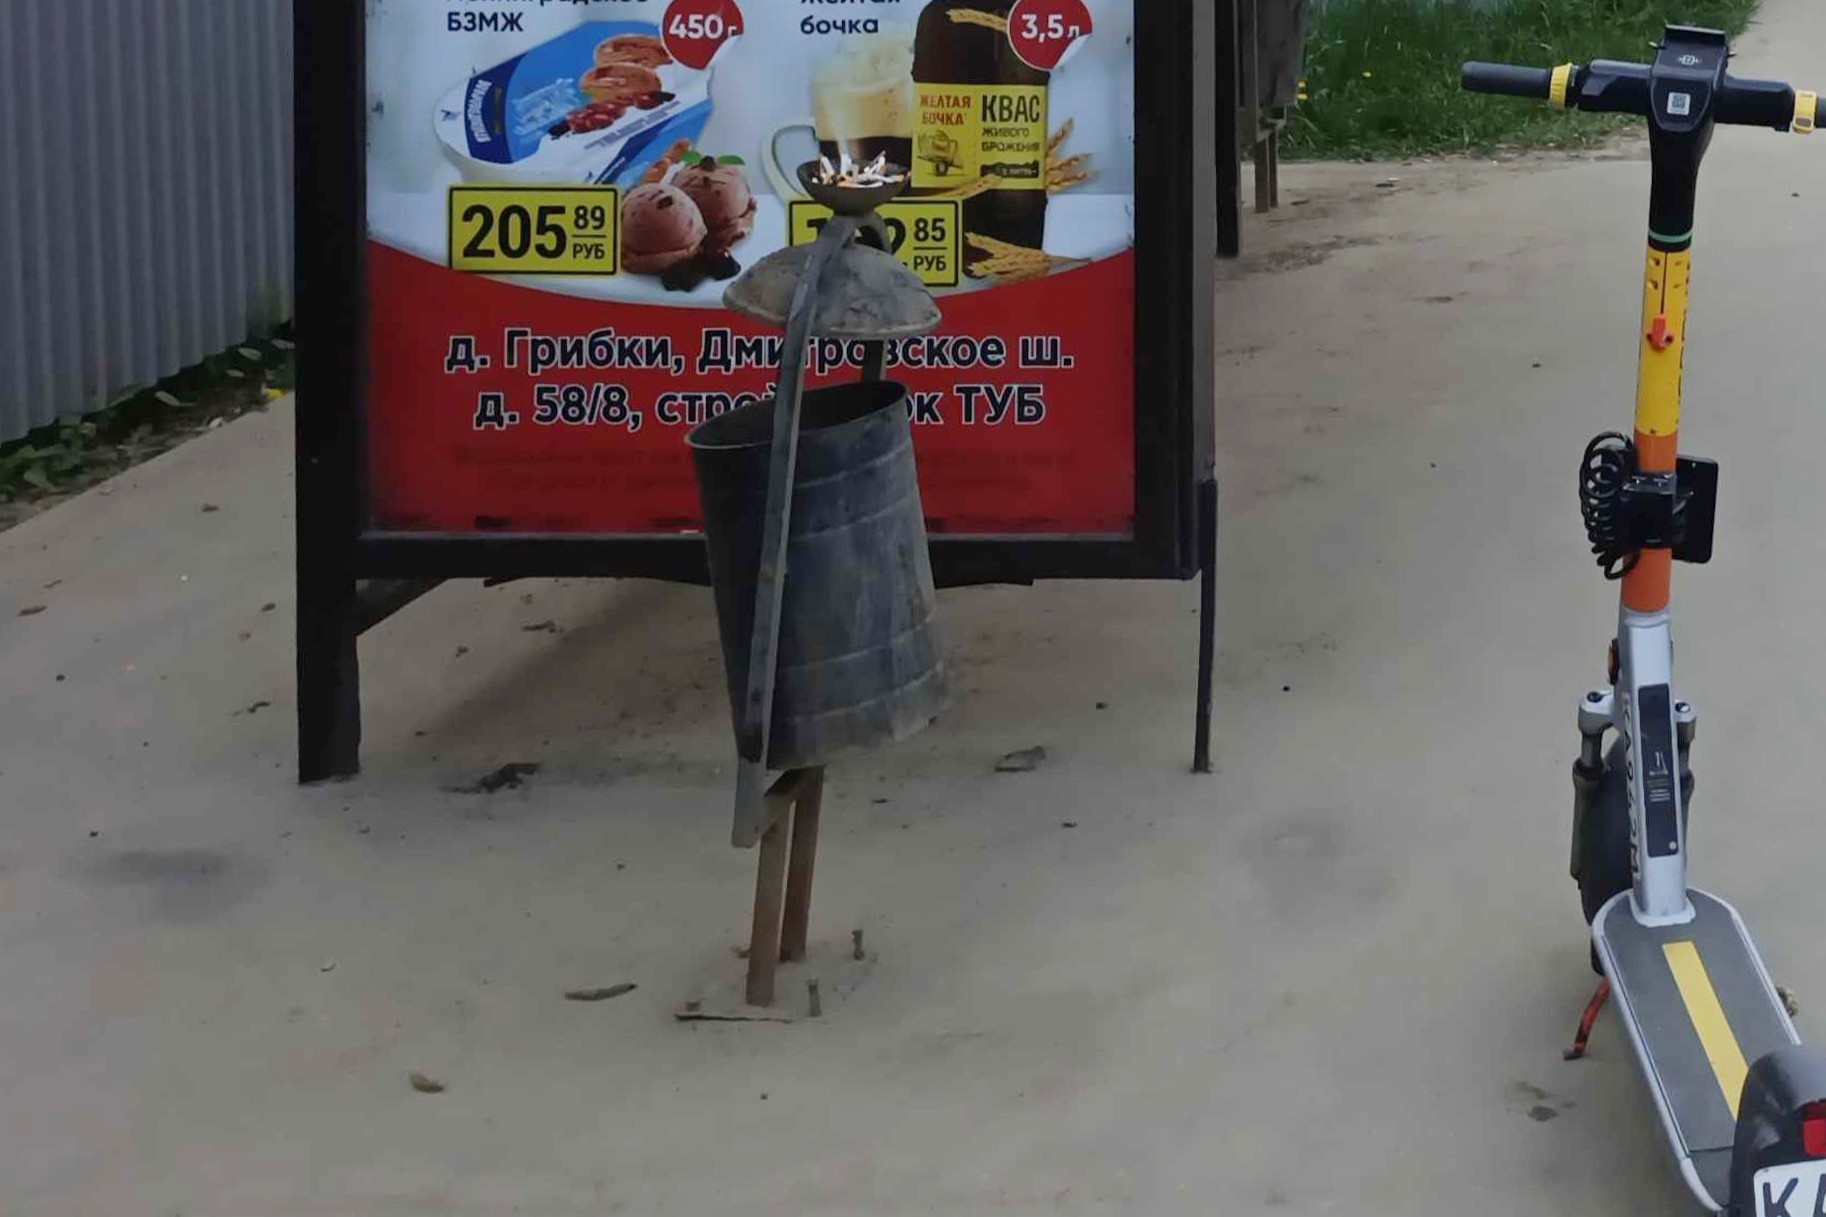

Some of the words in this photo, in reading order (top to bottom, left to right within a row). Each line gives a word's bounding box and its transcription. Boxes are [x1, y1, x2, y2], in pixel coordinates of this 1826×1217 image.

[447, 11, 524, 32] БЗМЖ
[669, 14, 724, 40] 450
[800, 15, 879, 35] бочка
[1021, 14, 1064, 43] 3,5
[982, 94, 1040, 123] КВАС
[574, 205, 605, 230] 89
[914, 218, 945, 242] 85
[462, 204, 567, 259] 205
[572, 244, 605, 260] РУБ
[914, 255, 946, 271] РУБ
[444, 335, 490, 374] д.
[504, 327, 684, 375] Грибки,
[1019, 336, 1075, 369] ш.
[473, 392, 519, 430] д.
[533, 383, 643, 433] 58/8,
[954, 384, 1046, 424] ТУБ
